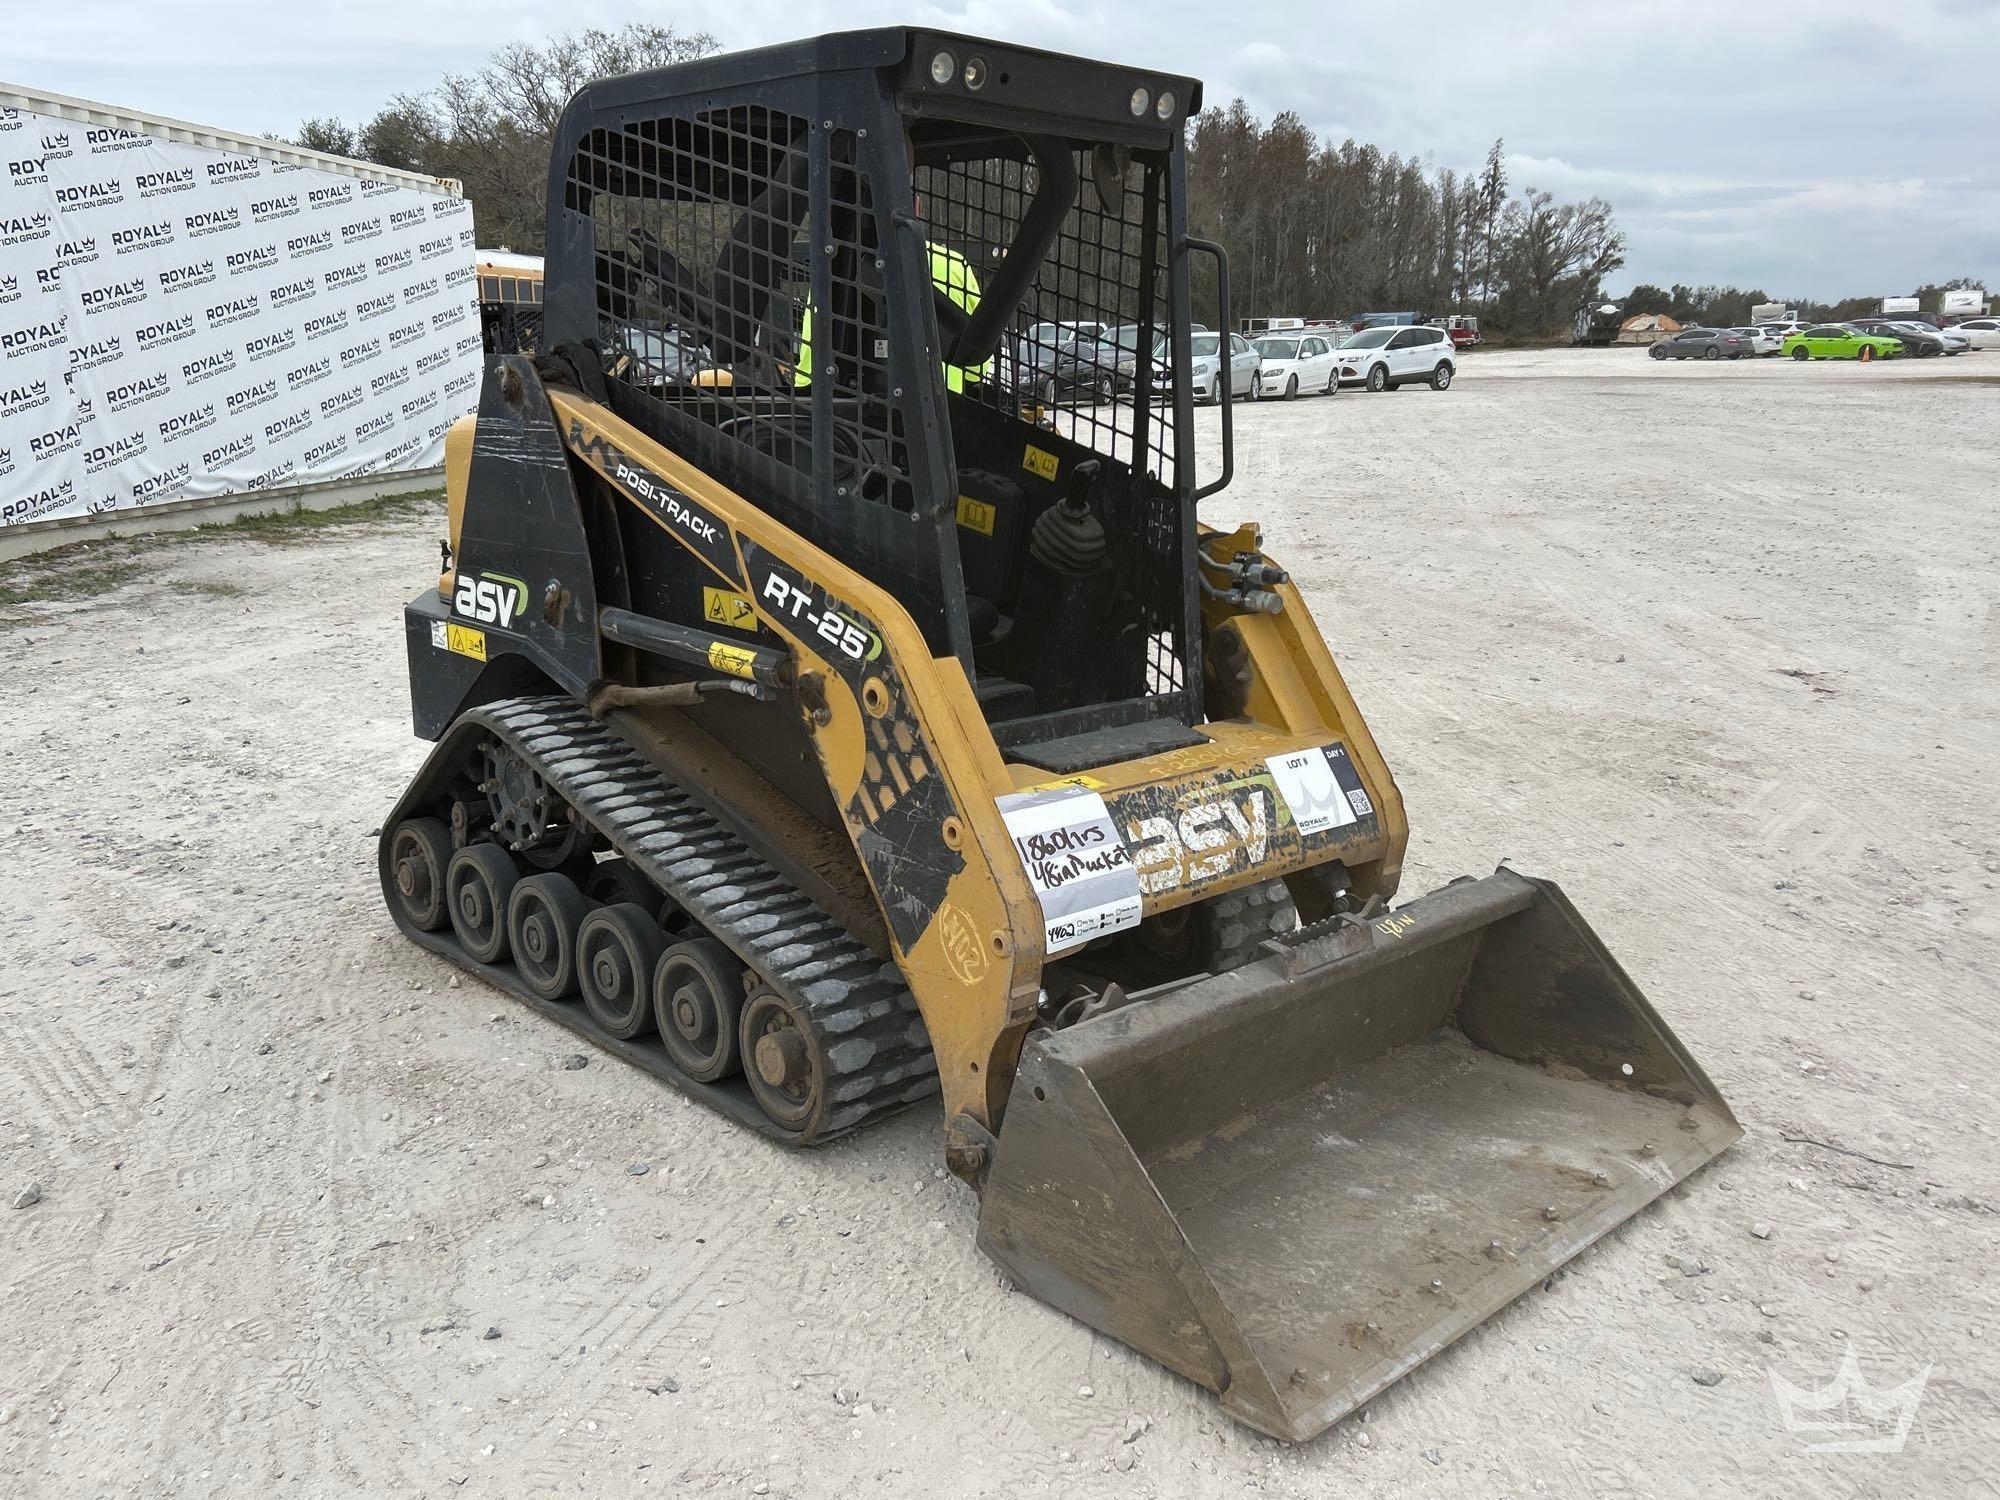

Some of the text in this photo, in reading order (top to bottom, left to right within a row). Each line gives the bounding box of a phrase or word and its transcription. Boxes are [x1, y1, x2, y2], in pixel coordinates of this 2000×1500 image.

[91, 139, 152, 154] AUCTION GROUP
[207, 159, 248, 176] ROYAL
[136, 170, 181, 189] ROYAL
[210, 172, 260, 185] AUCTION GROUP
[56, 183, 108, 203] ROYAL
[141, 183, 196, 198] AUCTION GROUP
[309, 186, 343, 202] ROYAL
[61, 196, 123, 213] AUCTION GROUP
[251, 197, 289, 215] ROYAL
[312, 197, 352, 210] AUCTION GROUP
[433, 200, 460, 212] ROYAL
[185, 210, 228, 229] ROYAL
[255, 208, 300, 224] AUCTION GROUP
[390, 210, 418, 224] ROYAL
[20, 230, 50, 243] GROUP
[112, 225, 159, 245] ROYAL
[189, 222, 241, 238] AUCTION GROUP
[342, 221, 373, 237] ROYAL
[116, 236, 174, 255] AUCTION GROUP
[287, 234, 323, 250] ROYAL
[291, 243, 333, 259] AUCTION GROUP
[419, 240, 446, 254] ROYAL
[73, 253, 99, 266] GROUP
[226, 248, 269, 267] ROYAL
[230, 258, 278, 276] AUCTION GROUP
[375, 254, 405, 268] ROYAL
[159, 265, 203, 285] ROYAL
[164, 275, 216, 294] AUCTION GROUP
[324, 267, 358, 284] ROYAL
[328, 275, 367, 291] AUCTION GROUP
[445, 268, 470, 282] ROYAL
[81, 283, 132, 305] ROYAL
[270, 283, 306, 300] ROYAL
[273, 291, 316, 309] AUCTION GROUP
[403, 283, 431, 298] ROYAL
[86, 293, 147, 316] AUCTION GROUP
[206, 301, 247, 320] ROYAL
[357, 298, 388, 314] ROYAL
[210, 309, 260, 329] AUCTION GROUP
[304, 315, 338, 333] ROYAL
[432, 310, 458, 325] ROYAL
[1, 322, 59, 349] ROYAL
[136, 320, 182, 342] ROYAL
[140, 329, 196, 351] AUCTION GROUP
[307, 322, 348, 341] AUCTION GROUP
[389, 325, 418, 342] ROYAL
[7, 342, 47, 359] AUCTION
[246, 334, 284, 354] ROYAL
[250, 341, 295, 362] AUCTION GROUP
[456, 335, 480, 350] ROYAL
[96, 352, 123, 365] GROUP
[340, 344, 372, 362] ROYAL
[416, 352, 443, 369] ROYAL
[183, 356, 223, 377] ROYAL
[187, 363, 236, 386] AUCTION GROUP
[287, 364, 321, 383] ROYAL
[291, 370, 332, 391] AUCTION GROUP
[371, 371, 401, 389] ROYAL
[444, 378, 468, 394] ROYAL
[107, 379, 154, 404] ROYAL
[111, 387, 170, 413] AUCTION GROUP
[226, 385, 267, 406] ROYAL
[19, 396, 50, 413] GROUP
[230, 392, 278, 416] AUCTION GROUP
[320, 392, 354, 412] ROYAL
[323, 398, 363, 419] AUCTION GROUP
[402, 397, 430, 413] ROYAL
[159, 411, 204, 435] ROYAL
[164, 418, 217, 444] AUCTION GROUP
[265, 416, 302, 436] ROYAL
[355, 419, 386, 436] ROYAL
[429, 419, 453, 438] ROYAL
[269, 422, 312, 445] AUCTION GROUP
[36, 442, 75, 462] AUCTION
[84, 438, 132, 464] ROYAL
[87, 446, 147, 475] AUCTION GROUP
[203, 441, 244, 465] ROYAL
[208, 447, 256, 473] AUCTION GROUP
[304, 441, 339, 462] ROYAL
[308, 447, 347, 469] AUCTION GROUP
[385, 444, 414, 461] ROYAL
[133, 470, 179, 496] ROYAL
[248, 466, 286, 491] ROYAL
[136, 476, 192, 505] AUCTION GROUP
[3, 488, 59, 519] ROYAL
[7, 495, 77, 526] AUCTION GROUP
[617, 464, 716, 544] POSI-TRACK
[763, 572, 867, 659] RT-25
[1286, 758, 1302, 769] LOT
[1326, 749, 1340, 759] DAY
[1299, 817, 1323, 828] ROYAL
